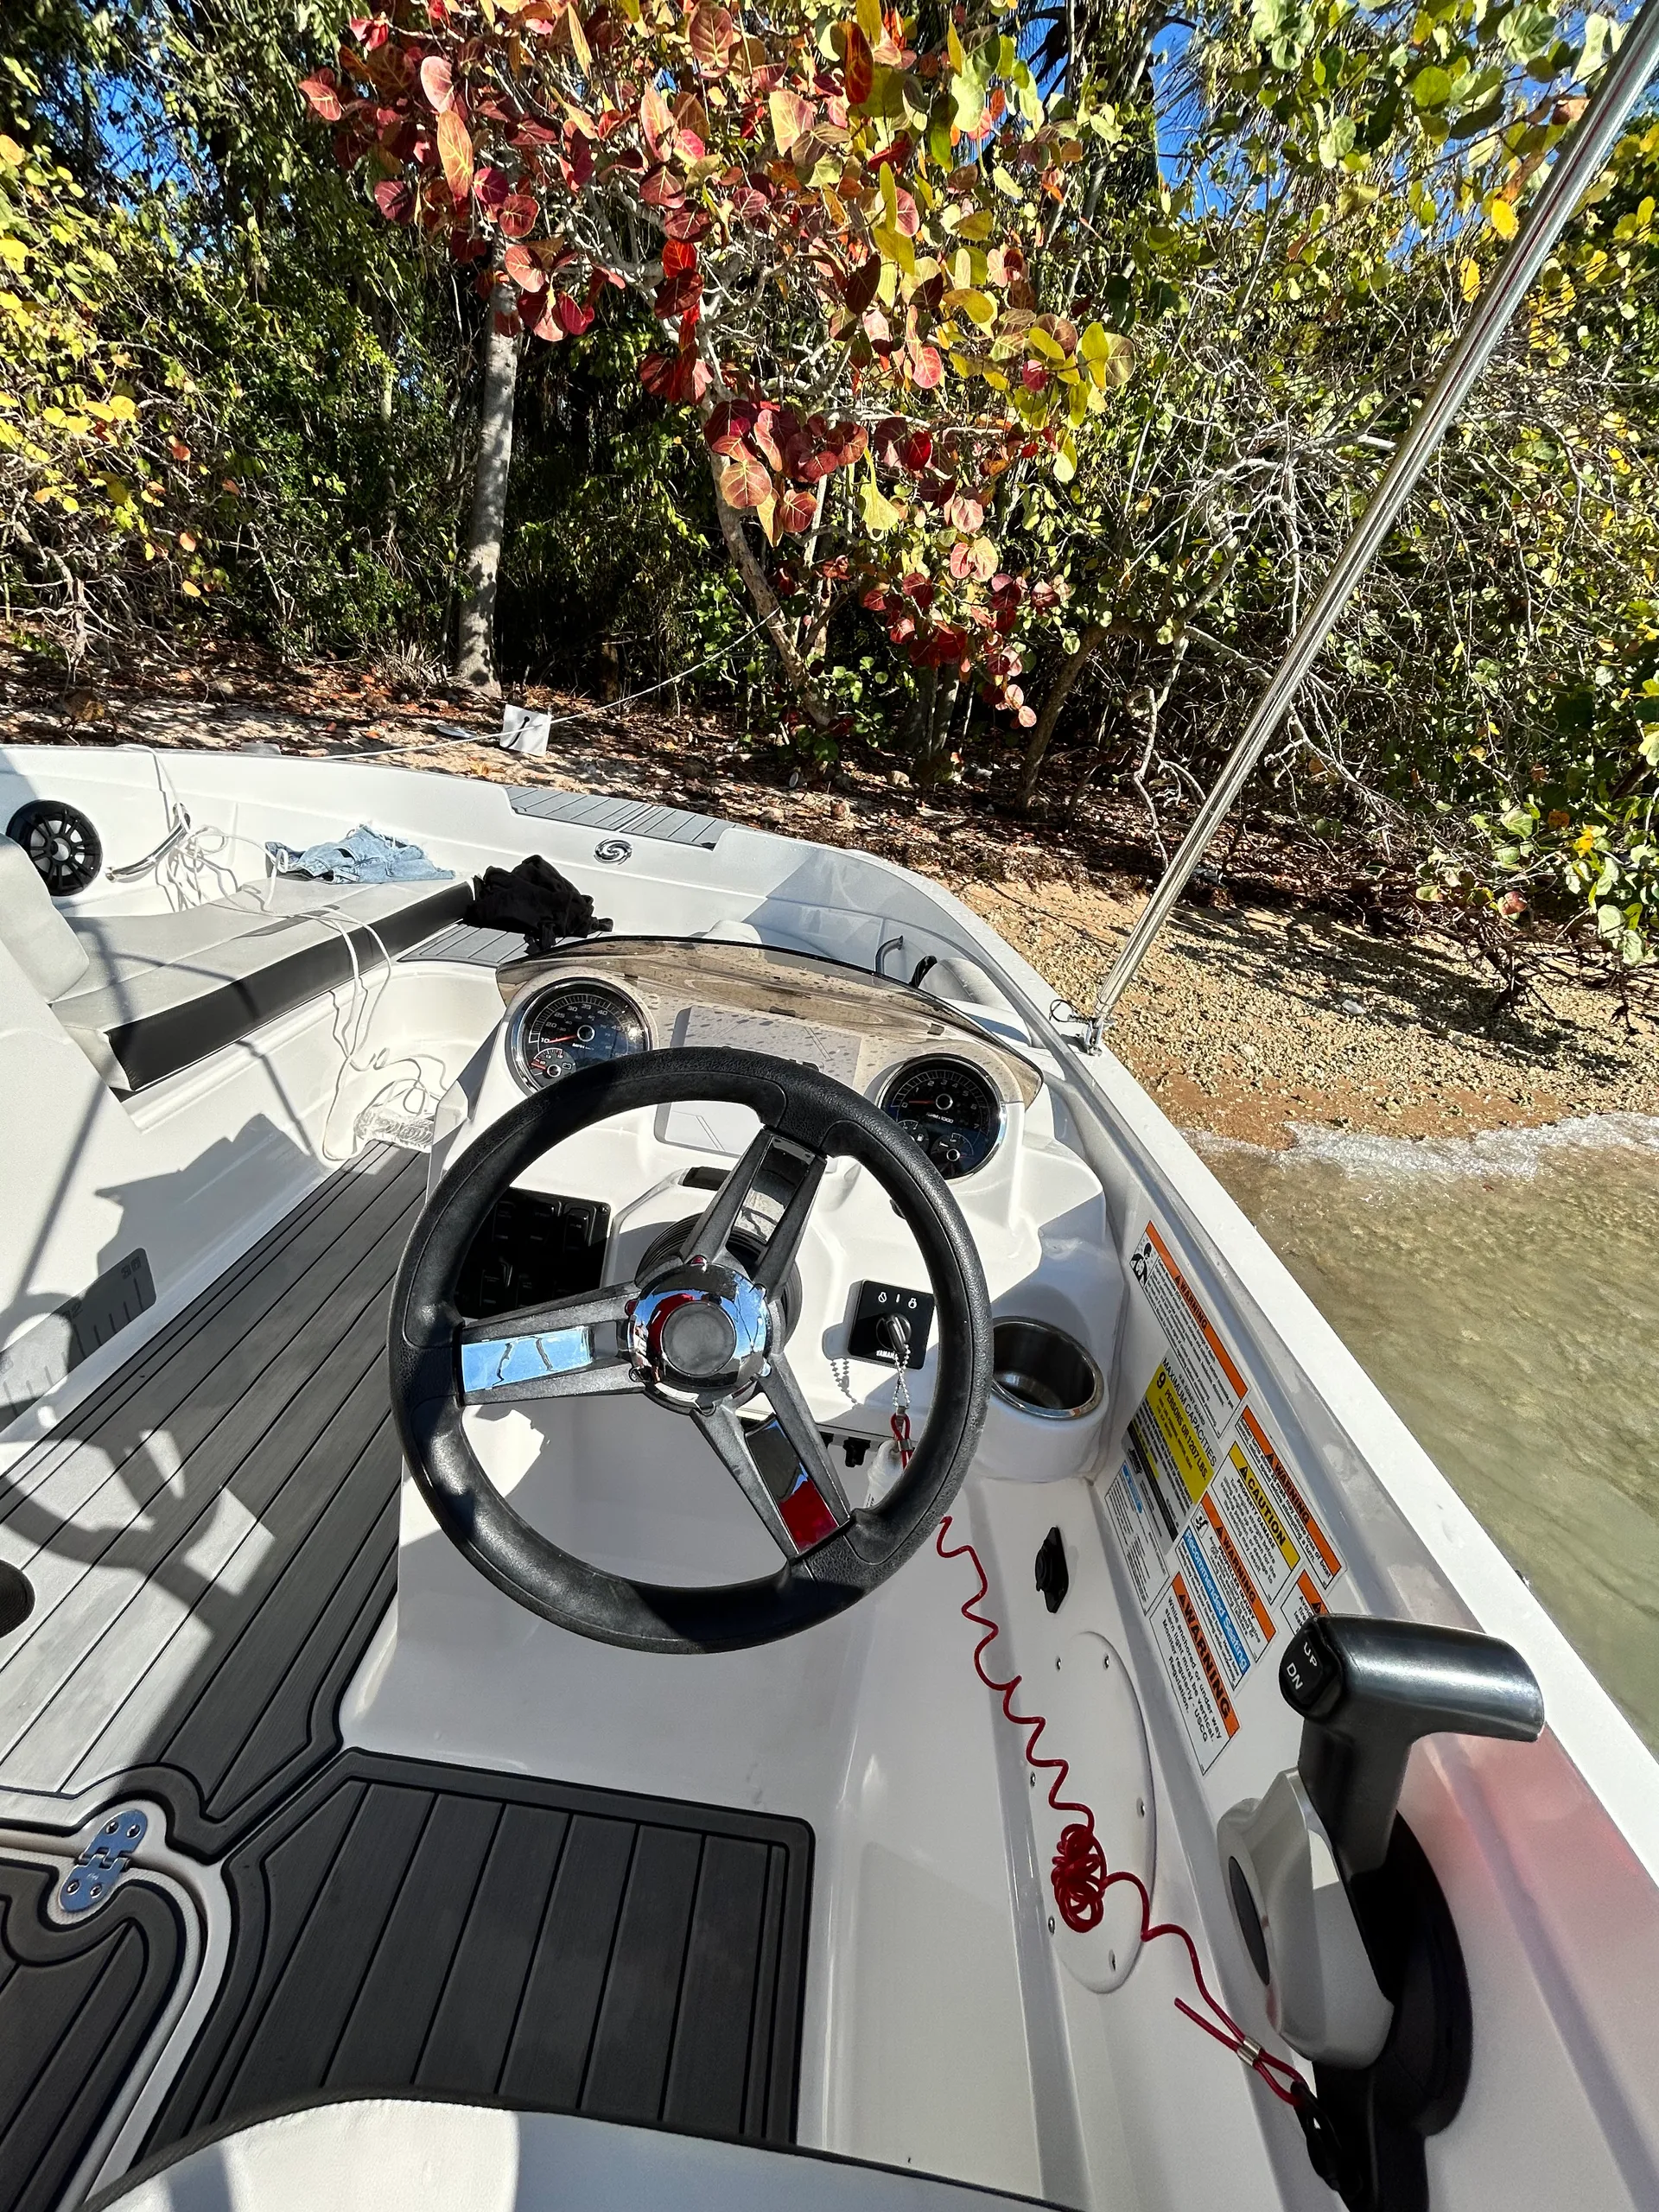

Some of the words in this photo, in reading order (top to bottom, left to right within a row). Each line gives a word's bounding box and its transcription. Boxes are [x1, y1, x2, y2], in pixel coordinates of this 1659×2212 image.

[1179, 1281, 1208, 1332] WARNING
[876, 1350, 896, 1360] YAMAH
[1155, 1369, 1167, 1392] 9
[1163, 1387, 1184, 1427] PERSONS
[1180, 1421, 1190, 1440] OR
[1185, 1433, 1200, 1461] 1207
[1195, 1456, 1209, 1482] LBS.
[1161, 1356, 1187, 1406] MAXIMUM
[1183, 1401, 1218, 1469] CAPACITIES
[1183, 1383, 1195, 1405] COAST
[1192, 1402, 1206, 1427] GUARD
[1230, 1478, 1239, 1494] Turn
[1236, 1491, 1250, 1516] engine
[1248, 1513, 1263, 1542] straight
[1262, 1539, 1276, 1565] before
[1236, 1477, 1258, 1517] PROPERTY
[1255, 1515, 1276, 1551] DAMAGE
[1246, 1475, 1287, 1547] CAUTION
[1248, 1441, 1262, 1465] reduce
[1259, 1462, 1271, 1484] speed
[1269, 1481, 1283, 1504] before
[1281, 1502, 1303, 1541] attempting
[1251, 1436, 1262, 1455] turns
[1260, 1452, 1272, 1473] above
[1270, 1471, 1277, 1484] 25
[1274, 1480, 1287, 1500] mph
[1284, 1497, 1295, 1515] may
[1293, 1512, 1307, 1536] cause
[1305, 1533, 1317, 1552] loss
[1314, 1549, 1321, 1560] of
[1319, 1558, 1332, 1579] boat
[1273, 1462, 1311, 1525] WARNING
[1228, 1509, 1243, 1538] cowling
[1240, 1535, 1250, 1553] may
[1231, 1494, 1244, 1518] engine
[1243, 1516, 1249, 1528] up
[1248, 1525, 1254, 1535] or
[1252, 1532, 1264, 1554] down
[1262, 1552, 1270, 1566] for
[1268, 1563, 1277, 1580] the
[1248, 1537, 1254, 1548] or
[1251, 1545, 1268, 1577] damage
[1267, 1573, 1274, 1586] to
[1184, 1528, 1226, 1618] Recommended
[1221, 1614, 1249, 1672] Seating
[1217, 1544, 1240, 1590] PROPELLER
[1238, 1588, 1255, 1621] INJURY
[1221, 1535, 1256, 1605] WARNING
[1161, 1617, 1178, 1656] Monitor
[1173, 1654, 1193, 1703] regularly
[1164, 1606, 1175, 1632] stern
[1172, 1630, 1184, 1656] light
[1181, 1654, 1193, 1682] must
[1191, 1681, 1199, 1698] be
[1196, 1695, 1216, 1743] vertical.
[1166, 1595, 1179, 1624] While
[1176, 1621, 1197, 1670] anchored
[1193, 1669, 1201, 1683] or
[1198, 1681, 1213, 1716] under
[1210, 1715, 1222, 1742] way
[1167, 1654, 1191, 1716] Regulation.
[1182, 1600, 1232, 1720] WARNING
[1287, 1662, 1304, 1690] DN
[1304, 1642, 1318, 1667] UP
